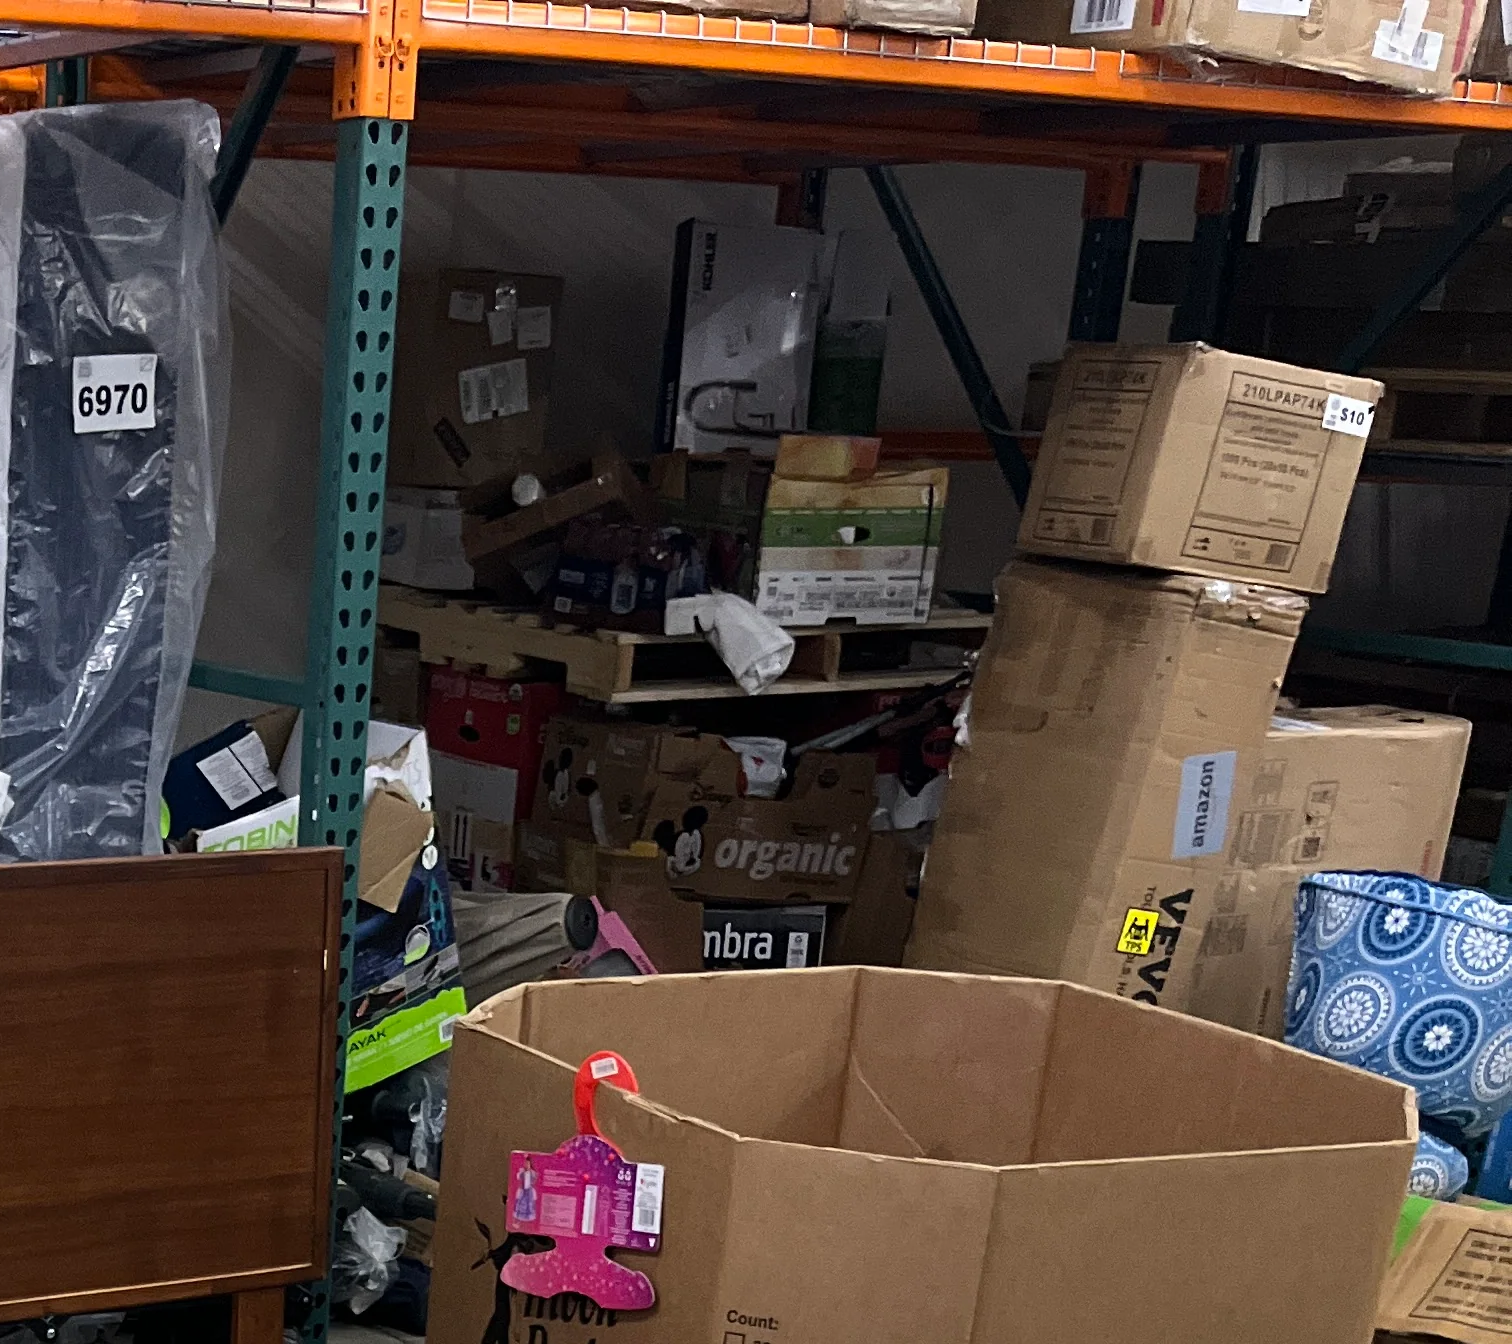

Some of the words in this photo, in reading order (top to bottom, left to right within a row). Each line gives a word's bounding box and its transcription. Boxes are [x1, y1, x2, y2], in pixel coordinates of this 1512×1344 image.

[78, 382, 148, 417] 6970
[1191, 760, 1216, 848] amazon
[714, 831, 857, 881] organic
[726, 1309, 779, 1331] Count:
